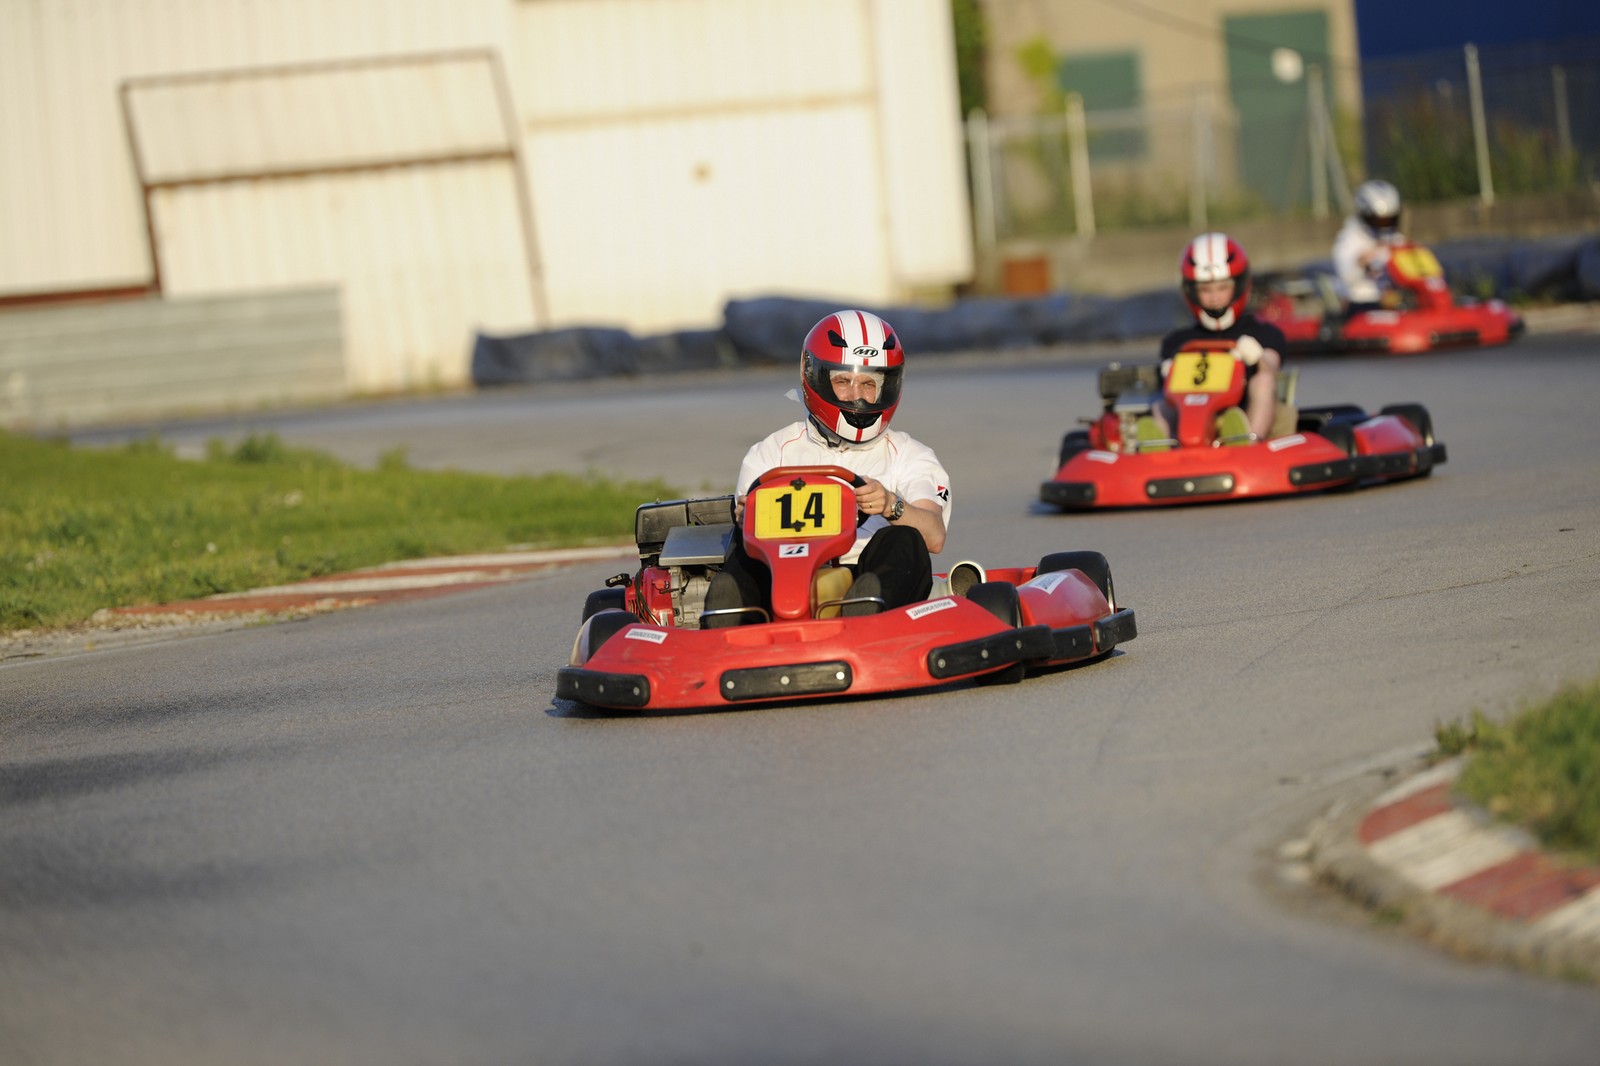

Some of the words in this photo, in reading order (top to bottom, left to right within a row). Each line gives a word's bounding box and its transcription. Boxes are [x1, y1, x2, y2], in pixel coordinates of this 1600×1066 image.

[853, 347, 878, 356] MT
[1194, 357, 1209, 385] 3
[775, 492, 825, 529] 14
